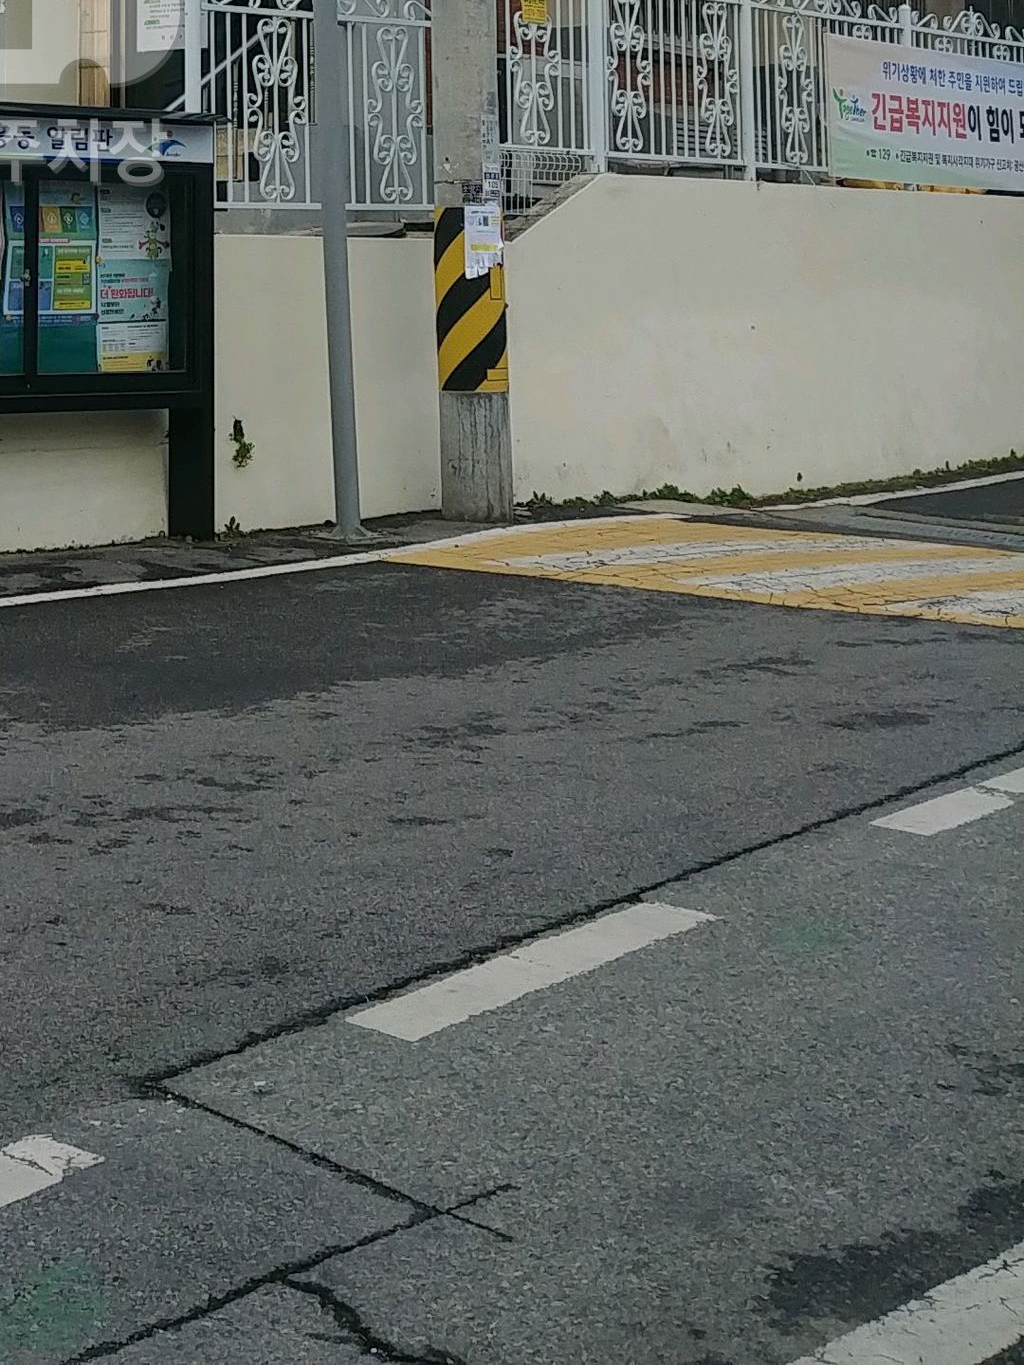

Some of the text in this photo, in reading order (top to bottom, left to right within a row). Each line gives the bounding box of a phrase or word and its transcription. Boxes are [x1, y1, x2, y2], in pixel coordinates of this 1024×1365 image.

[882, 61, 926, 85] 위기상황에
[929, 68, 946, 87] 처한
[948, 71, 972, 91] 주민을
[975, 75, 1006, 95] 지원하여
[872, 93, 982, 141] 긴급복지지원이
[986, 105, 1015, 144] 힘이
[878, 149, 891, 160] 129
